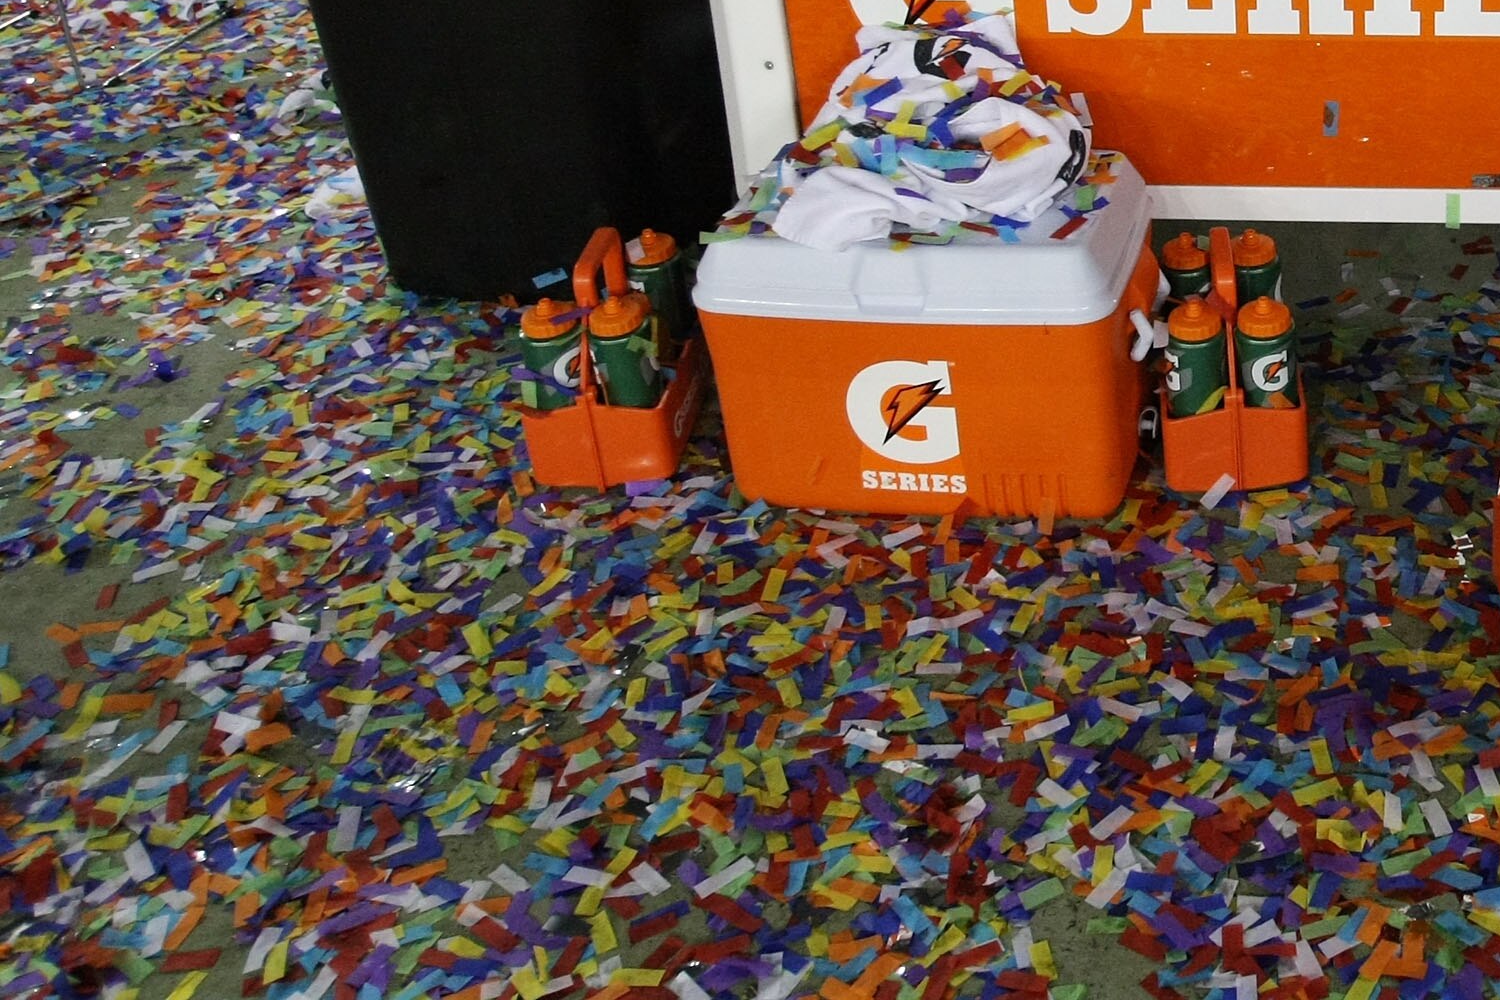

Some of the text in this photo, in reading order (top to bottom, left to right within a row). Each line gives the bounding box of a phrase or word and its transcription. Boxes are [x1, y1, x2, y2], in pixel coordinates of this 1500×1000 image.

[1250, 349, 1289, 393] G
[845, 360, 960, 465] G
[862, 469, 967, 495] SERIES
